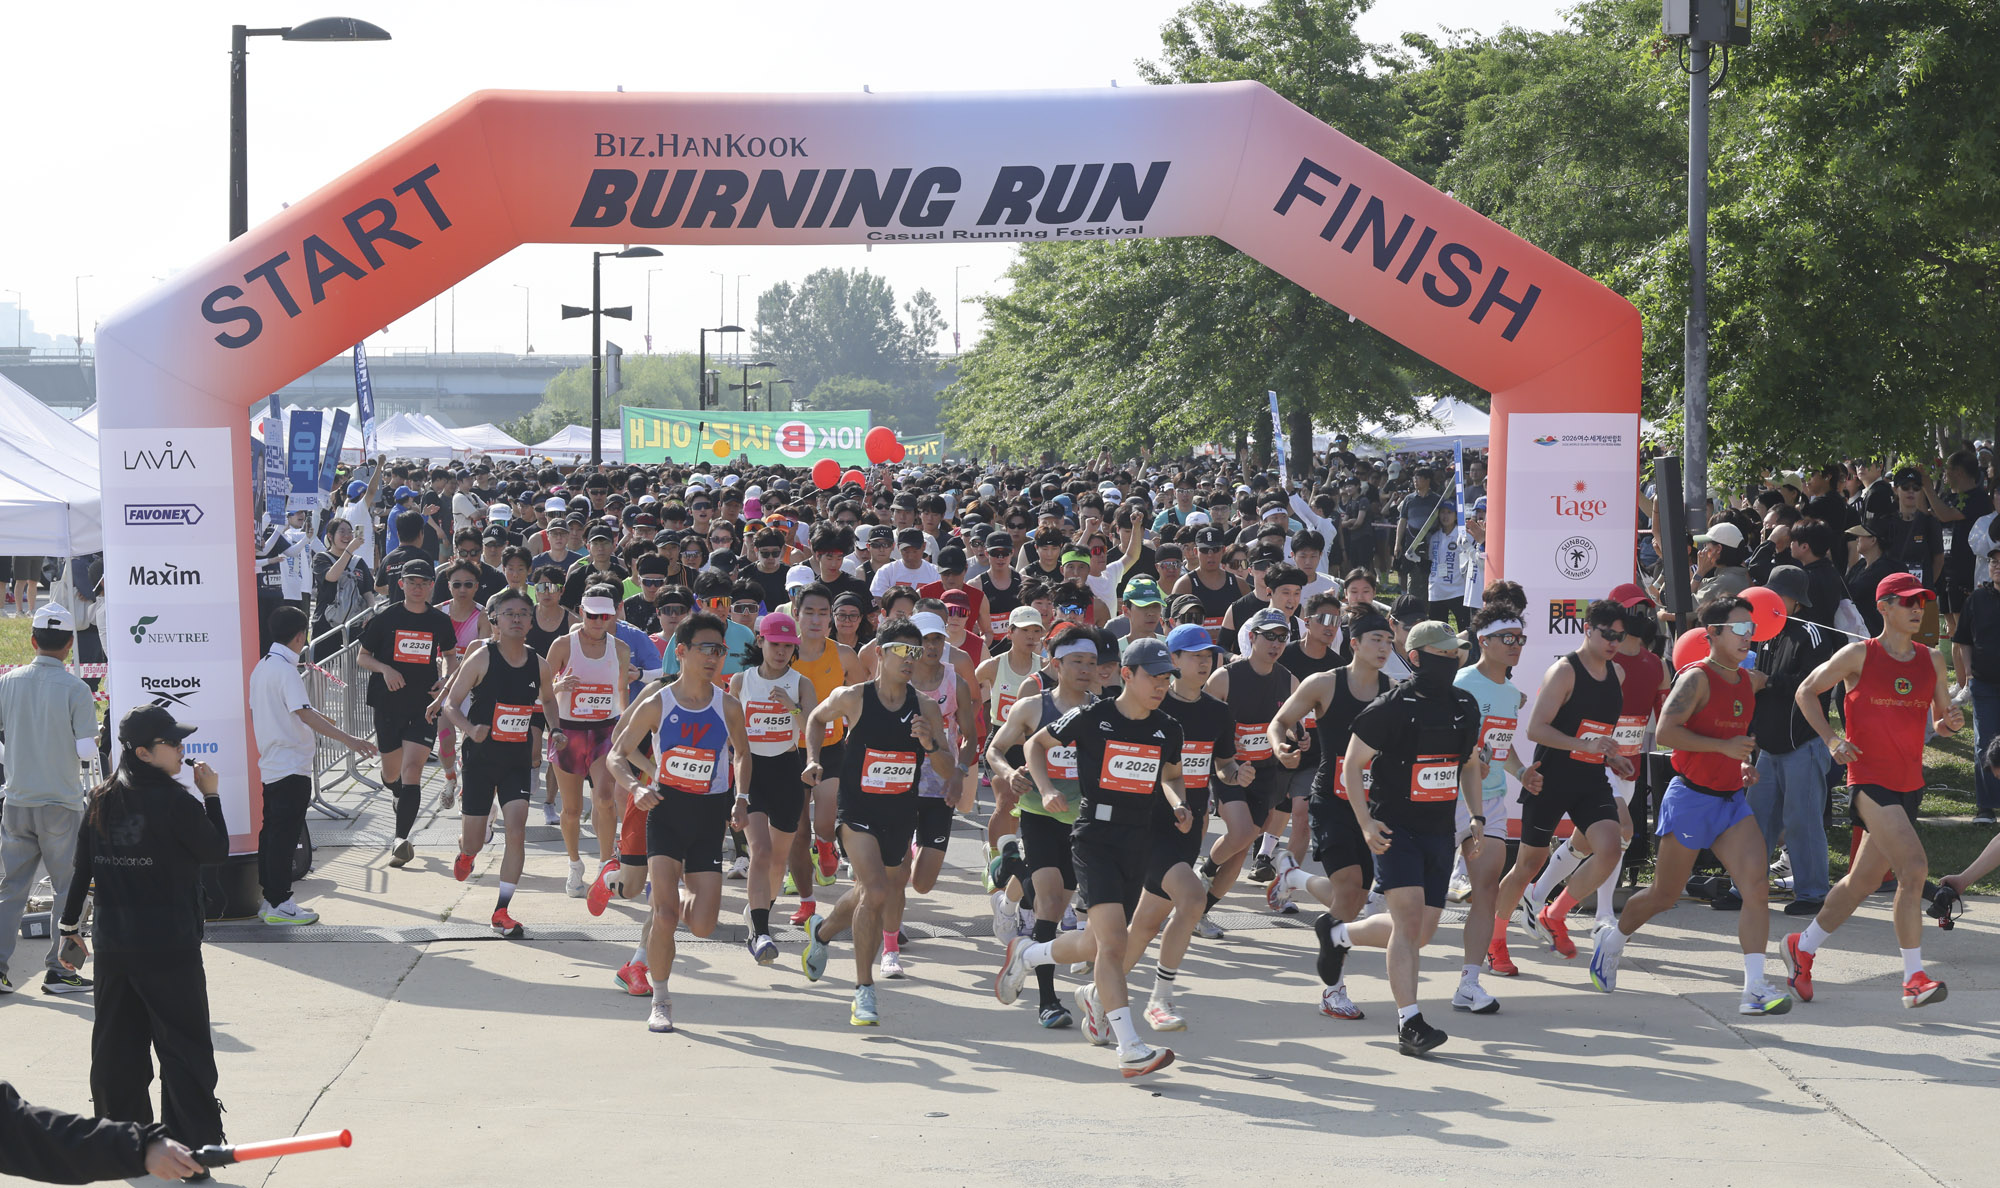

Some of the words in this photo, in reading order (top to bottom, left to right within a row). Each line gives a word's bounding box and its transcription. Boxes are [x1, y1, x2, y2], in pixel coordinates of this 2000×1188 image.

[570, 167, 962, 229] BURNING
[976, 161, 1172, 226] RUN
[867, 230, 945, 242] Casual
[952, 228, 1049, 241] Running
[1056, 225, 1144, 238] Festival
[201, 163, 452, 349] START
[1273, 157, 1542, 342] FINISH
[129, 508, 191, 521] FAVONEX
[1550, 495, 1608, 522] Tage
[1561, 538, 1594, 552] SUNBODY
[129, 562, 201, 586] Maxim
[1563, 568, 1591, 578] TANNING
[1550, 603, 1583, 618] BE-
[1549, 618, 1585, 634] KIN
[148, 633, 210, 644] NEWTREE
[409, 642, 430, 650] 2336
[141, 676, 201, 690] Reebok
[587, 696, 612, 705] 3675
[763, 716, 791, 725] 4555
[1052, 751, 1061, 759] M
[670, 761, 679, 769] M
[682, 761, 711, 774] 1610
[1114, 761, 1123, 769] M
[1125, 760, 1157, 774] 2026
[1183, 757, 1210, 768] 2551
[883, 766, 913, 776] 2304
[1423, 773, 1431, 781] M
[1434, 770, 1456, 781] 1901
[112, 856, 153, 866] balance
